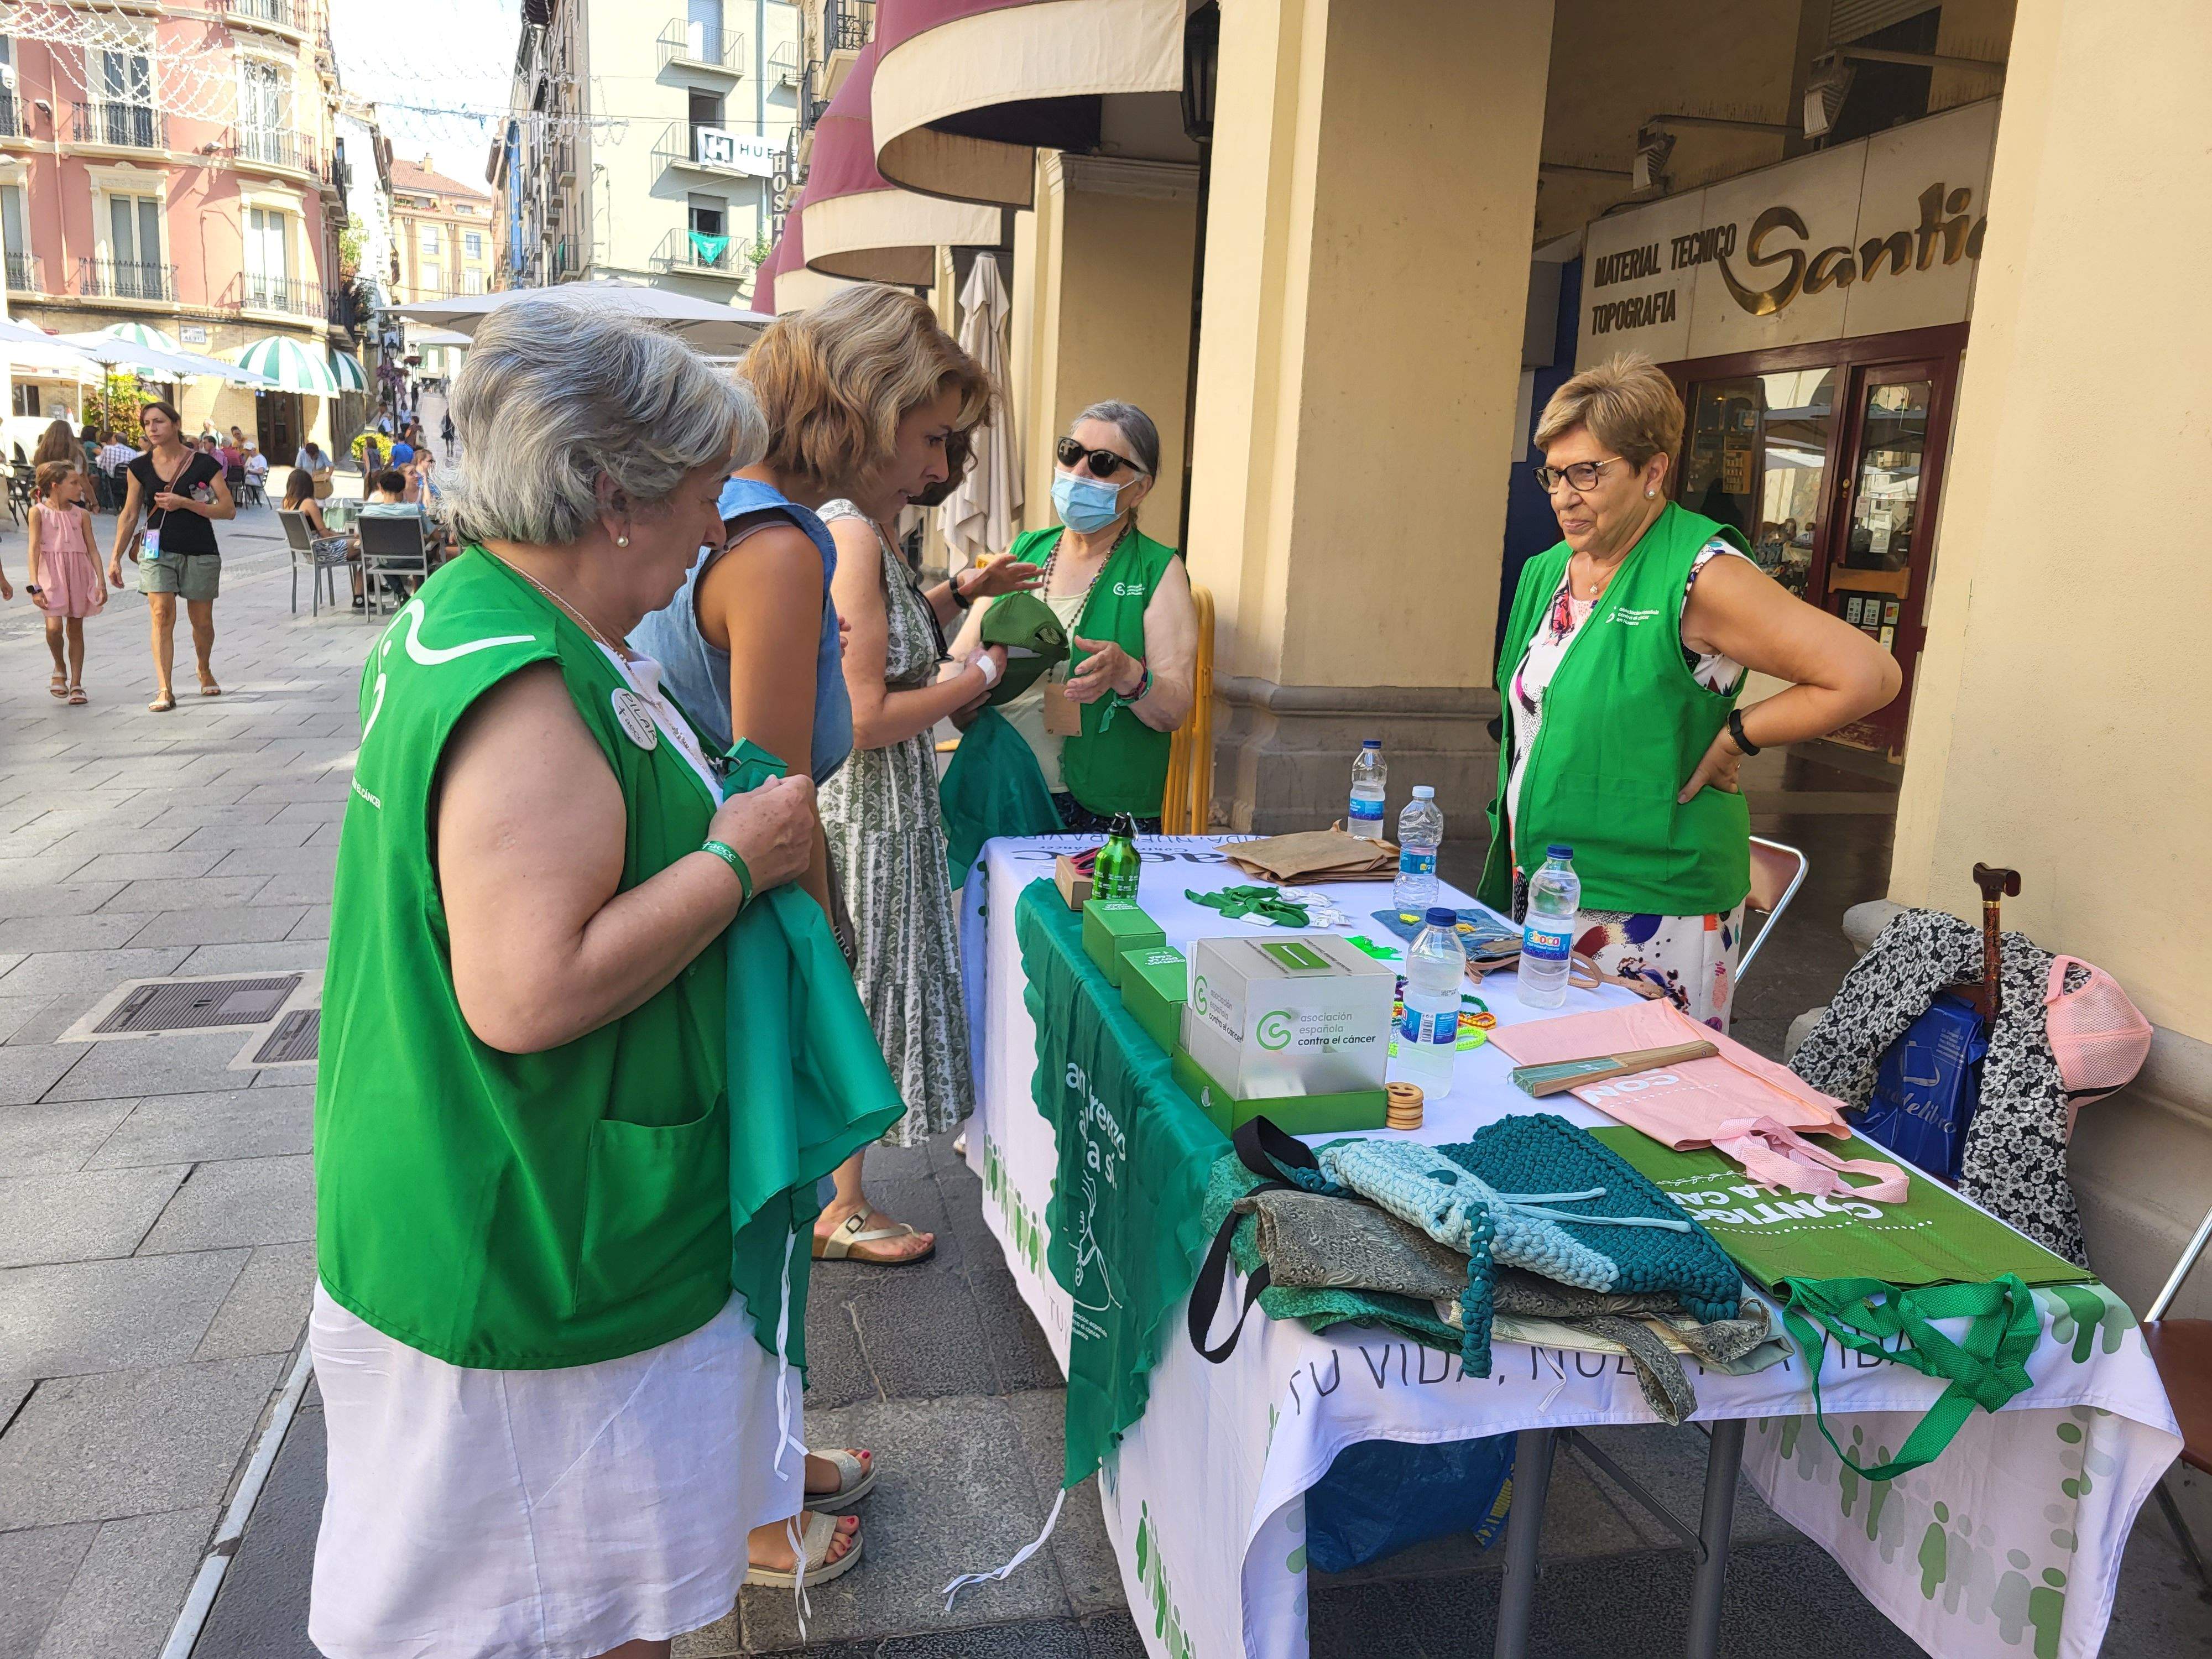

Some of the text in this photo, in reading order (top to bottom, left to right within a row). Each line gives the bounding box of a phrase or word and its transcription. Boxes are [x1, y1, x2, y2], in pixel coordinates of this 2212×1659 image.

[773, 155, 787, 249] HOST
[1594, 223, 1737, 288] MATERIAL TECNICO
[622, 692, 657, 741] PILAR
[361, 788, 381, 810] CÁNCE
[1211, 989, 1232, 1010] asociación
[1209, 1001, 1228, 1020] española
[1301, 1012, 1352, 1022] asociación
[1209, 1013, 1222, 1029] contra
[1222, 1021, 1227, 1032] el
[1299, 1024, 1343, 1034] española
[1343, 1035, 1376, 1044] cáncer
[1358, 1343, 1505, 1389] VID,
